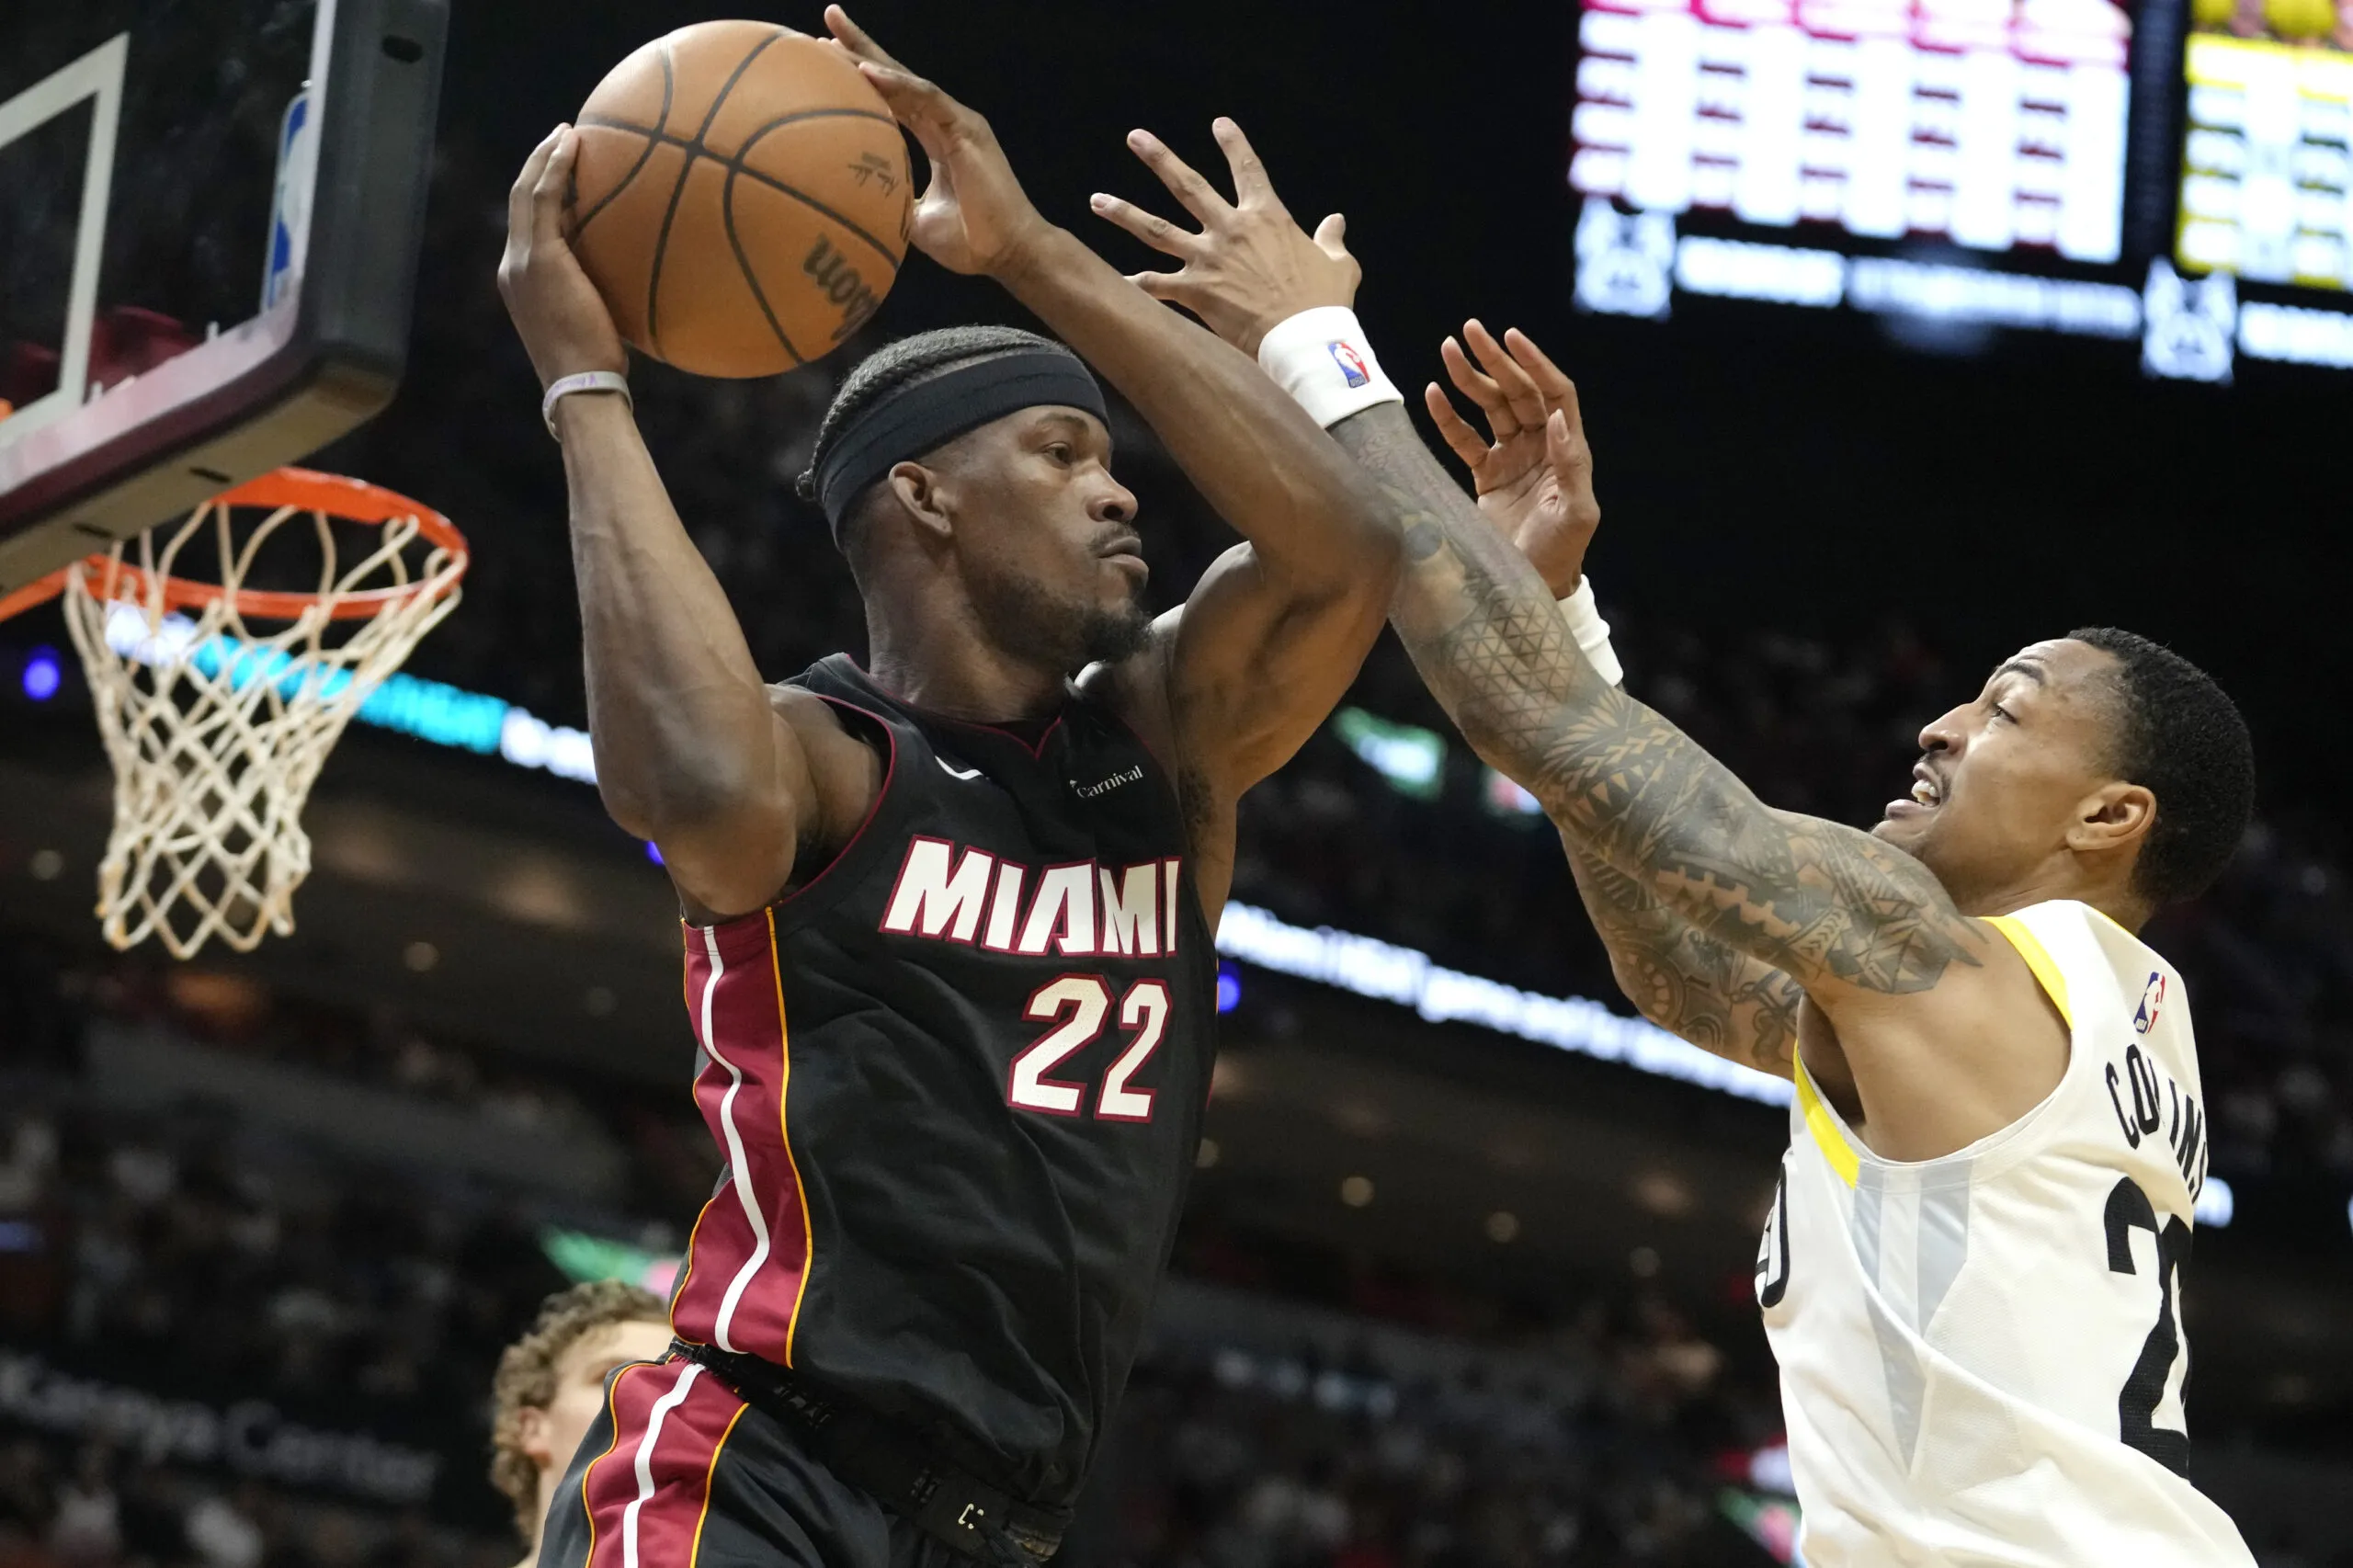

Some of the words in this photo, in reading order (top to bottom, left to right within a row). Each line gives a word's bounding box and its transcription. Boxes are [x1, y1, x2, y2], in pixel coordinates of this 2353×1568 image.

[1076, 765, 1143, 799] Carnival
[878, 834, 1183, 959] MIAMI
[1006, 972, 1173, 1123] 22
